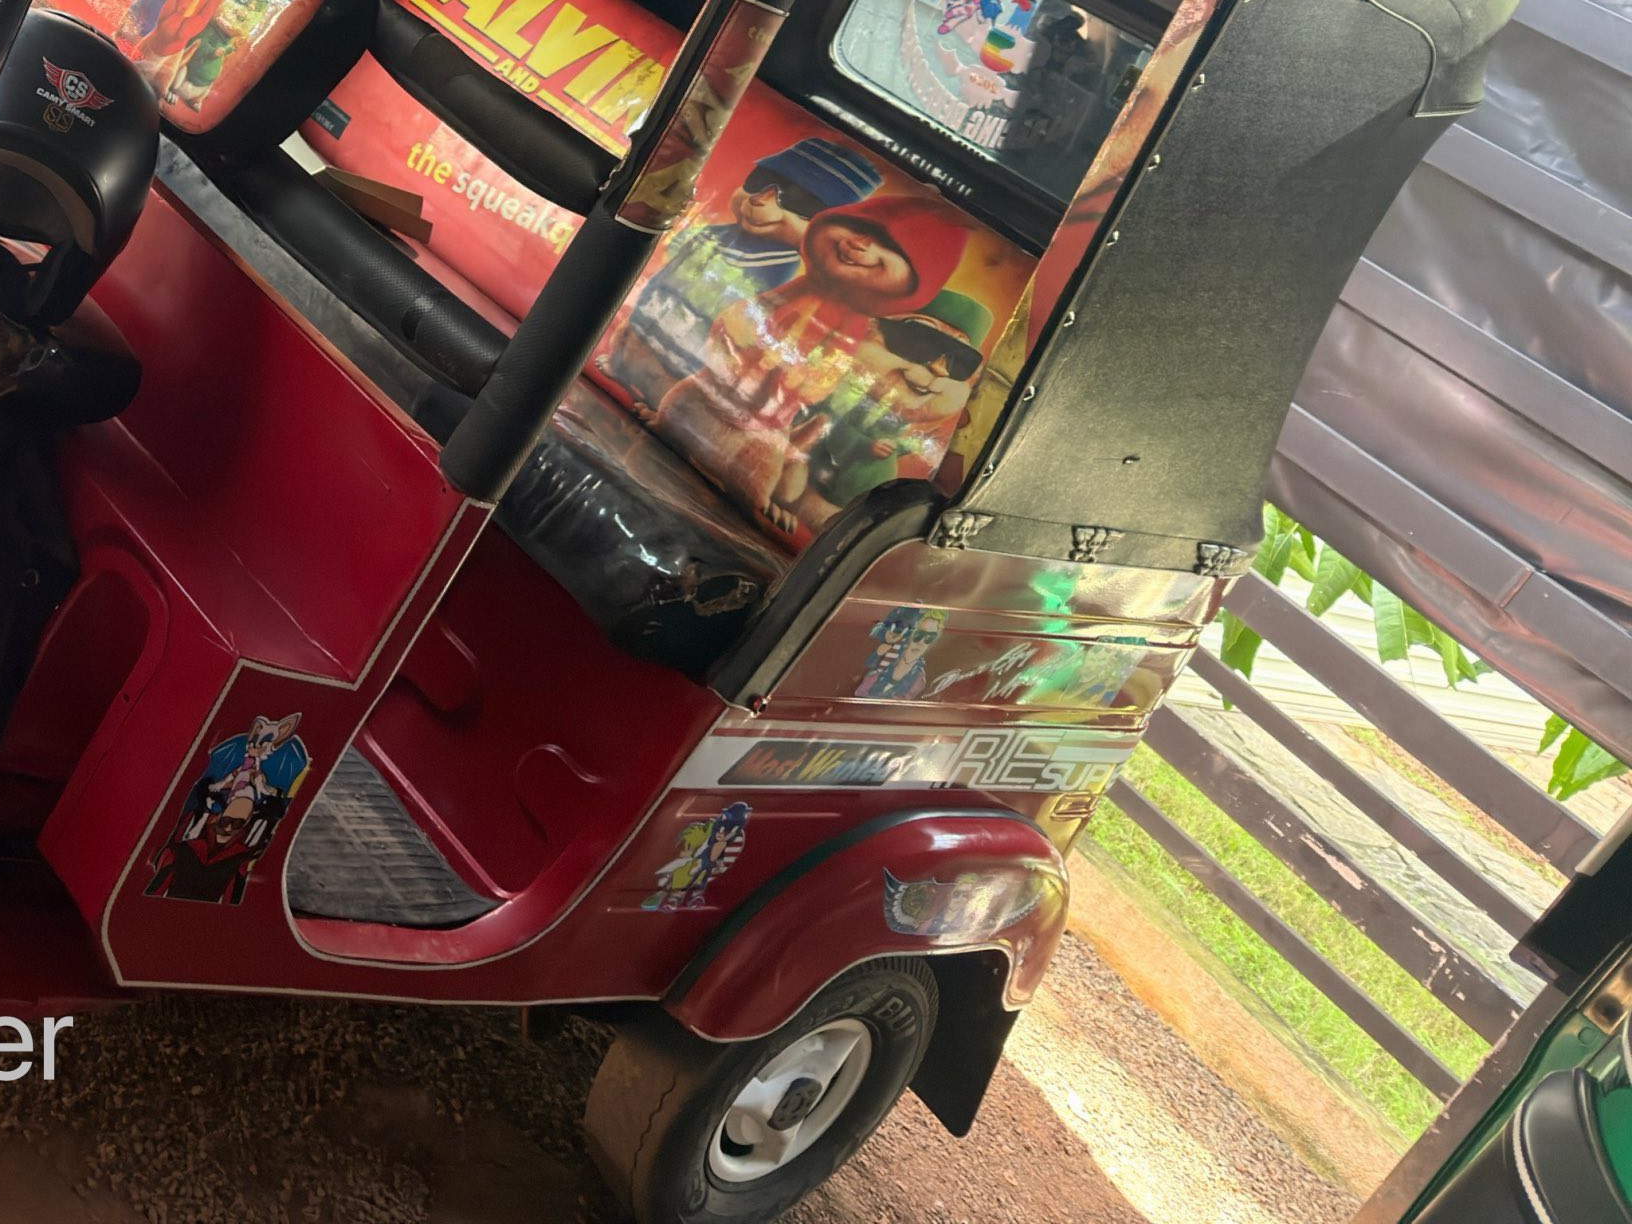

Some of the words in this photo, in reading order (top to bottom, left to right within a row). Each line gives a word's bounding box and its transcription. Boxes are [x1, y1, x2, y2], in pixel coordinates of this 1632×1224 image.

[64, 74, 89, 99] CS
[494, 60, 540, 94] AND
[36, 87, 65, 107] CAMY
[65, 104, 96, 127] SMART
[406, 142, 452, 184] the
[451, 172, 575, 256] squeakq
[737, 748, 810, 781] Most
[945, 728, 1066, 790] RE
